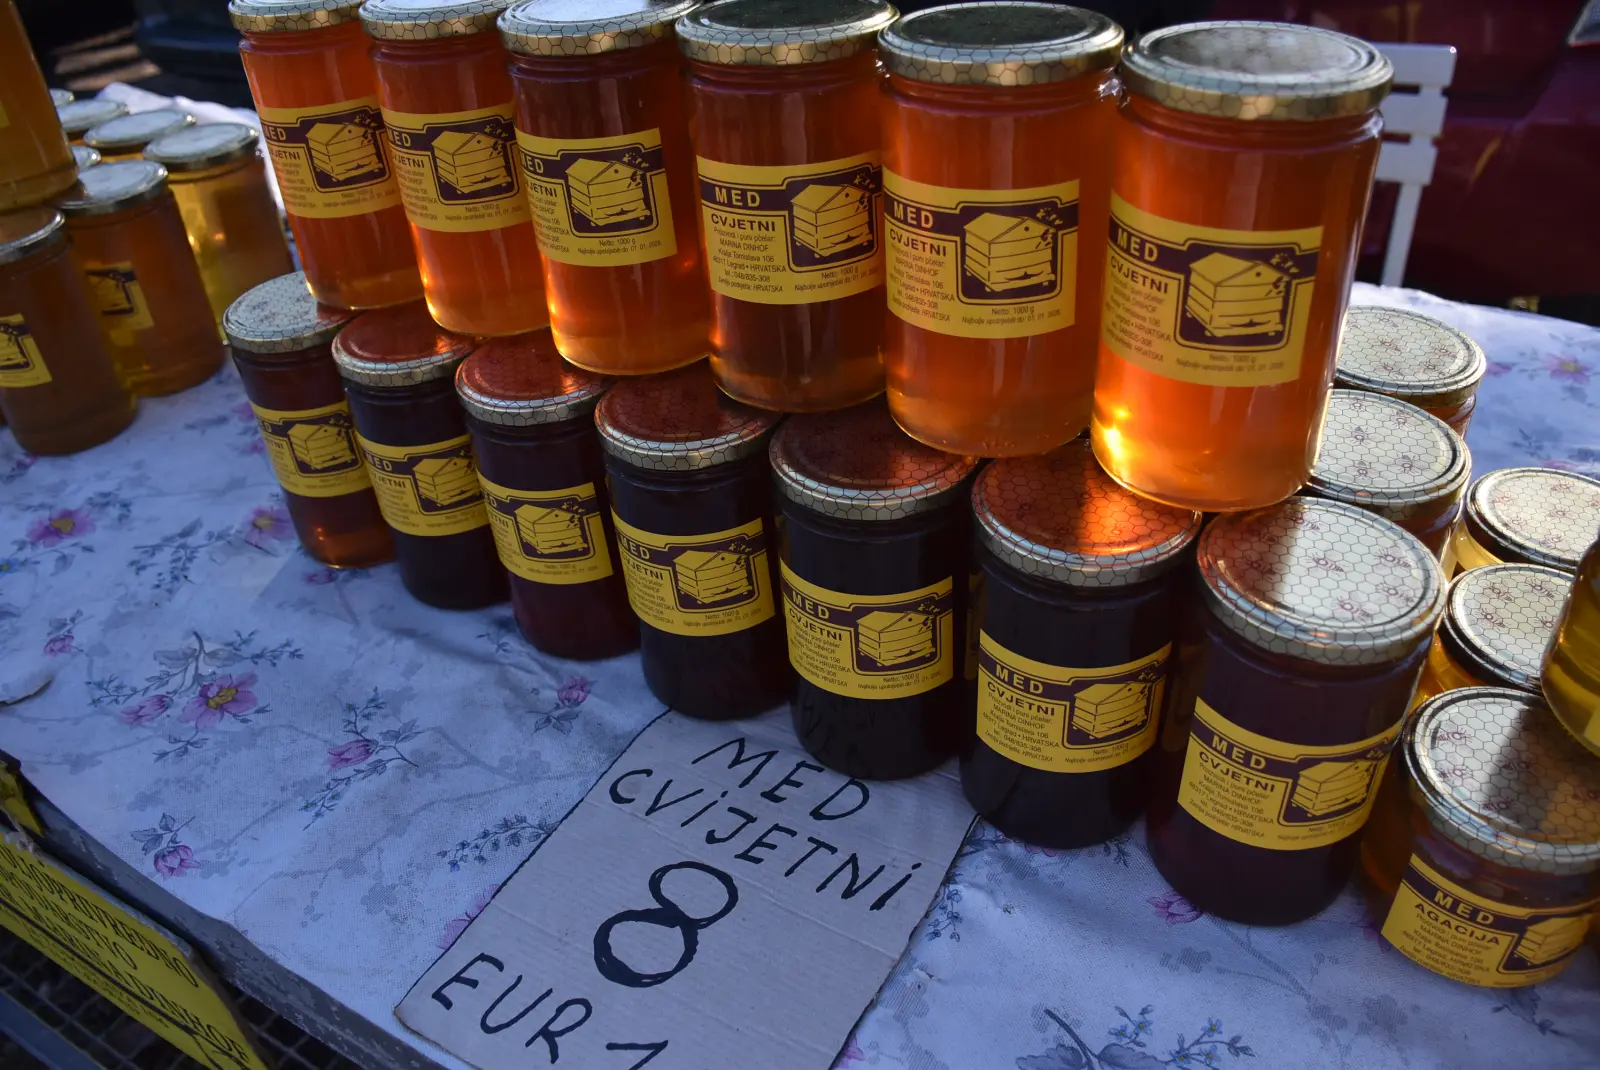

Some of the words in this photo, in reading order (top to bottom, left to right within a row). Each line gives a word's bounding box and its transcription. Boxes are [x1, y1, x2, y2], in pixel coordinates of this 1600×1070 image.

[715, 186, 760, 208] MED
[711, 213, 776, 232] CVJETNI
[894, 200, 934, 229] MED
[720, 238, 742, 249] MARINA
[743, 243, 769, 252] DINHOF
[890, 228, 947, 257] CVJETNI
[1117, 228, 1158, 262] MED
[727, 260, 746, 270] Legrad
[751, 264, 787, 273] HRVATSKA
[733, 252, 760, 262] Tomislava
[914, 264, 939, 277] DINHOF
[1110, 256, 1168, 294] CVJETNI
[754, 284, 784, 293] HRVATSKA
[920, 286, 956, 302] HRVATSKA
[932, 280, 944, 290] 106
[922, 306, 951, 322] HRVATSKA
[1014, 306, 1028, 314] 1000
[620, 534, 650, 560] MED
[792, 590, 830, 620] MED
[790, 608, 843, 642] CVJETNI
[814, 640, 836, 654] DINHOF
[820, 659, 852, 674] HRVATSKA
[996, 664, 1044, 694] MED
[822, 675, 848, 688] HRVATSKA
[987, 680, 1054, 717] CVJETNI
[994, 703, 1016, 721] MARINA
[1018, 717, 1046, 730] DINHOF
[1016, 708, 1030, 720] puni
[998, 722, 1017, 738] Legrad
[1022, 734, 1060, 749] HRVATSKA
[1006, 718, 1035, 738] Tomislava
[1037, 730, 1049, 738] 106
[1004, 734, 1042, 754] 048/835-308
[1022, 750, 1053, 763] HRVATSKA
[1212, 734, 1266, 770] MED
[692, 737, 870, 821] MED
[1199, 752, 1276, 793] CVJETNI
[1204, 774, 1230, 794] MARINA
[1231, 790, 1261, 806] DINHOF
[1217, 790, 1248, 811] Tomislava
[1252, 806, 1264, 814] 106
[1206, 794, 1228, 811] Legrad
[1234, 808, 1274, 825] HRVATSKA
[1231, 824, 1265, 838] HRVATSKA
[1434, 890, 1494, 925] MED
[593, 860, 739, 989] 8
[1414, 903, 1500, 946] AGACIJA
[1420, 924, 1450, 944] MARINA
[1450, 940, 1482, 955] DINHOF
[125, 971, 249, 1064] DINHOF
[431, 952, 593, 1065] EUR
